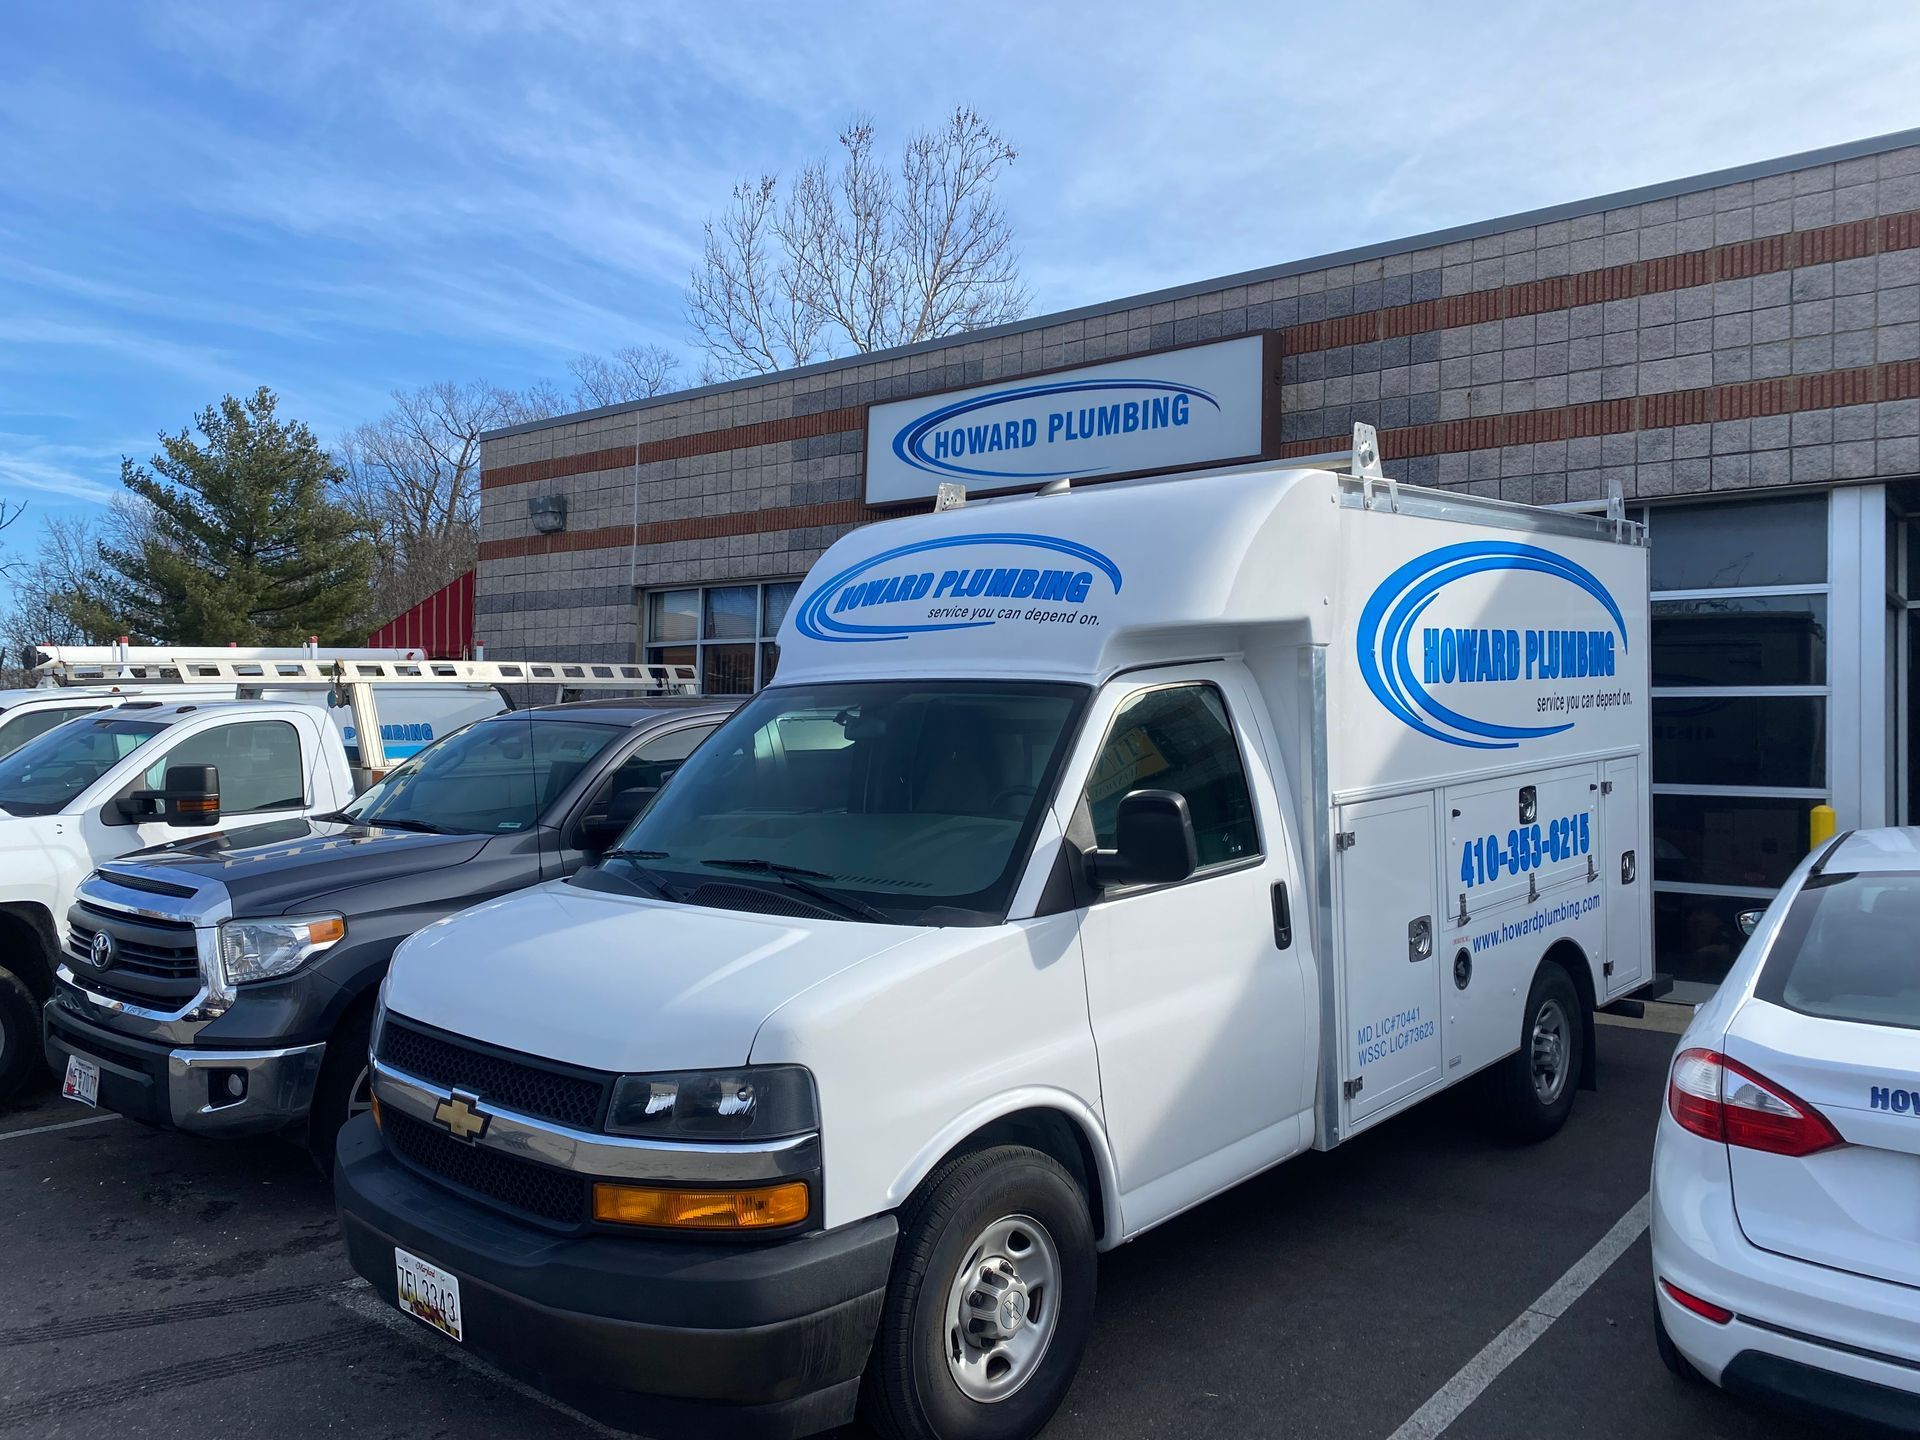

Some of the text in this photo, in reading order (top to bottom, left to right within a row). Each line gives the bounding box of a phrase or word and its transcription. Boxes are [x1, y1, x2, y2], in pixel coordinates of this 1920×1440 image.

[935, 393, 1189, 459] HOWARD PLUMBING
[833, 568, 1093, 614] HOWARD PLUMBING
[927, 605, 1101, 626] service you can depend on.
[1423, 628, 1615, 684] HOWARD PLUMBING
[1537, 688, 1633, 714] service you can depend on.
[343, 722, 434, 741] PMBING
[1461, 812, 1590, 888] 410-353-6215
[1472, 893, 1601, 953] www.howardplumbing.com
[1358, 1006, 1420, 1047] MD LIC#70441
[1358, 1020, 1435, 1067] WSSC LIC#73623
